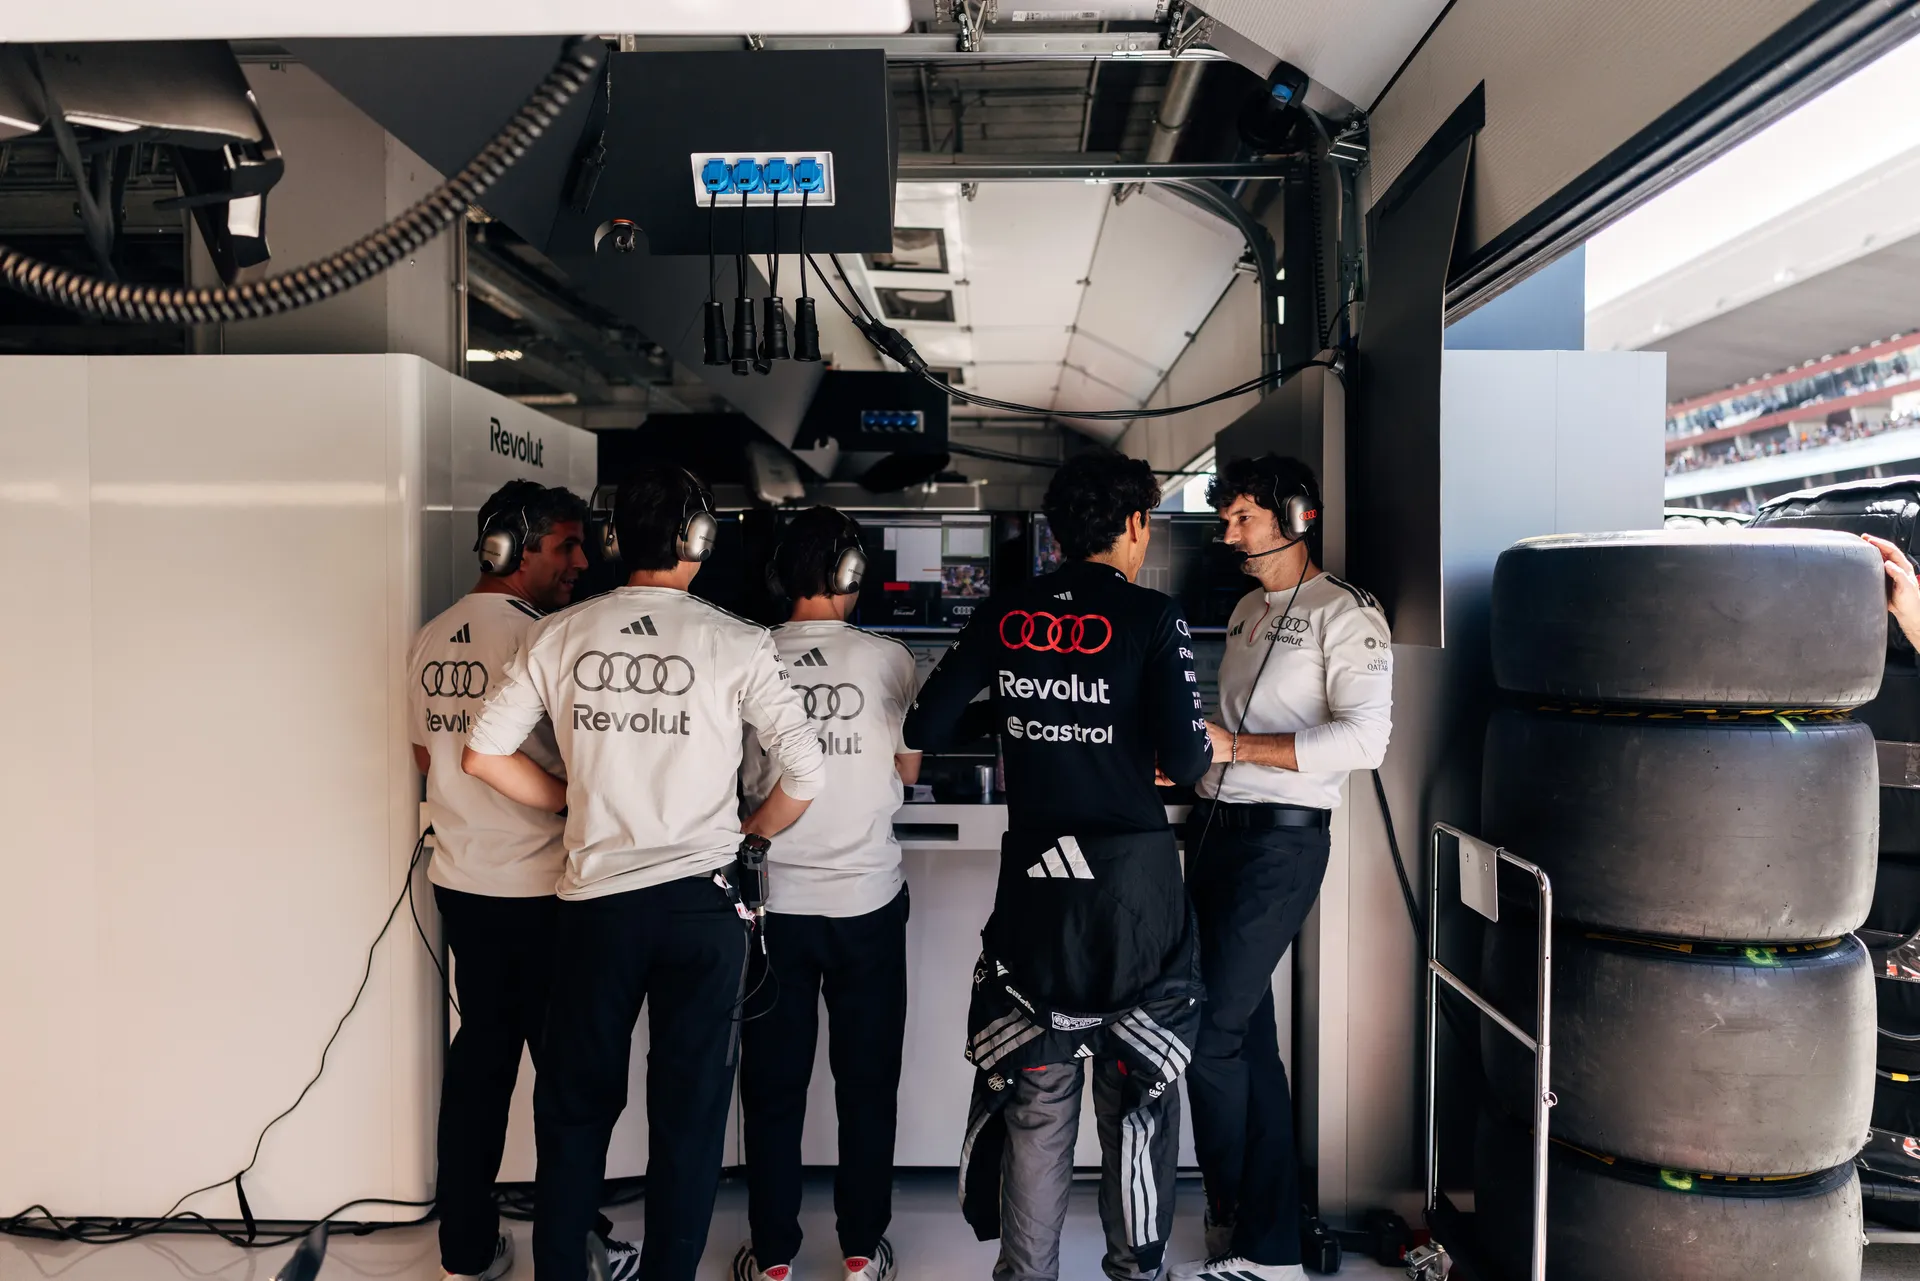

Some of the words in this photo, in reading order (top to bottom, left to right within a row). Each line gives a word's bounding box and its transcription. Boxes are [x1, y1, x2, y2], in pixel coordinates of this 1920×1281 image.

[490, 416, 544, 468] Revolut
[998, 669, 1111, 705] Revolut
[573, 703, 691, 736] Revolut
[1026, 720, 1113, 744] Castrol
